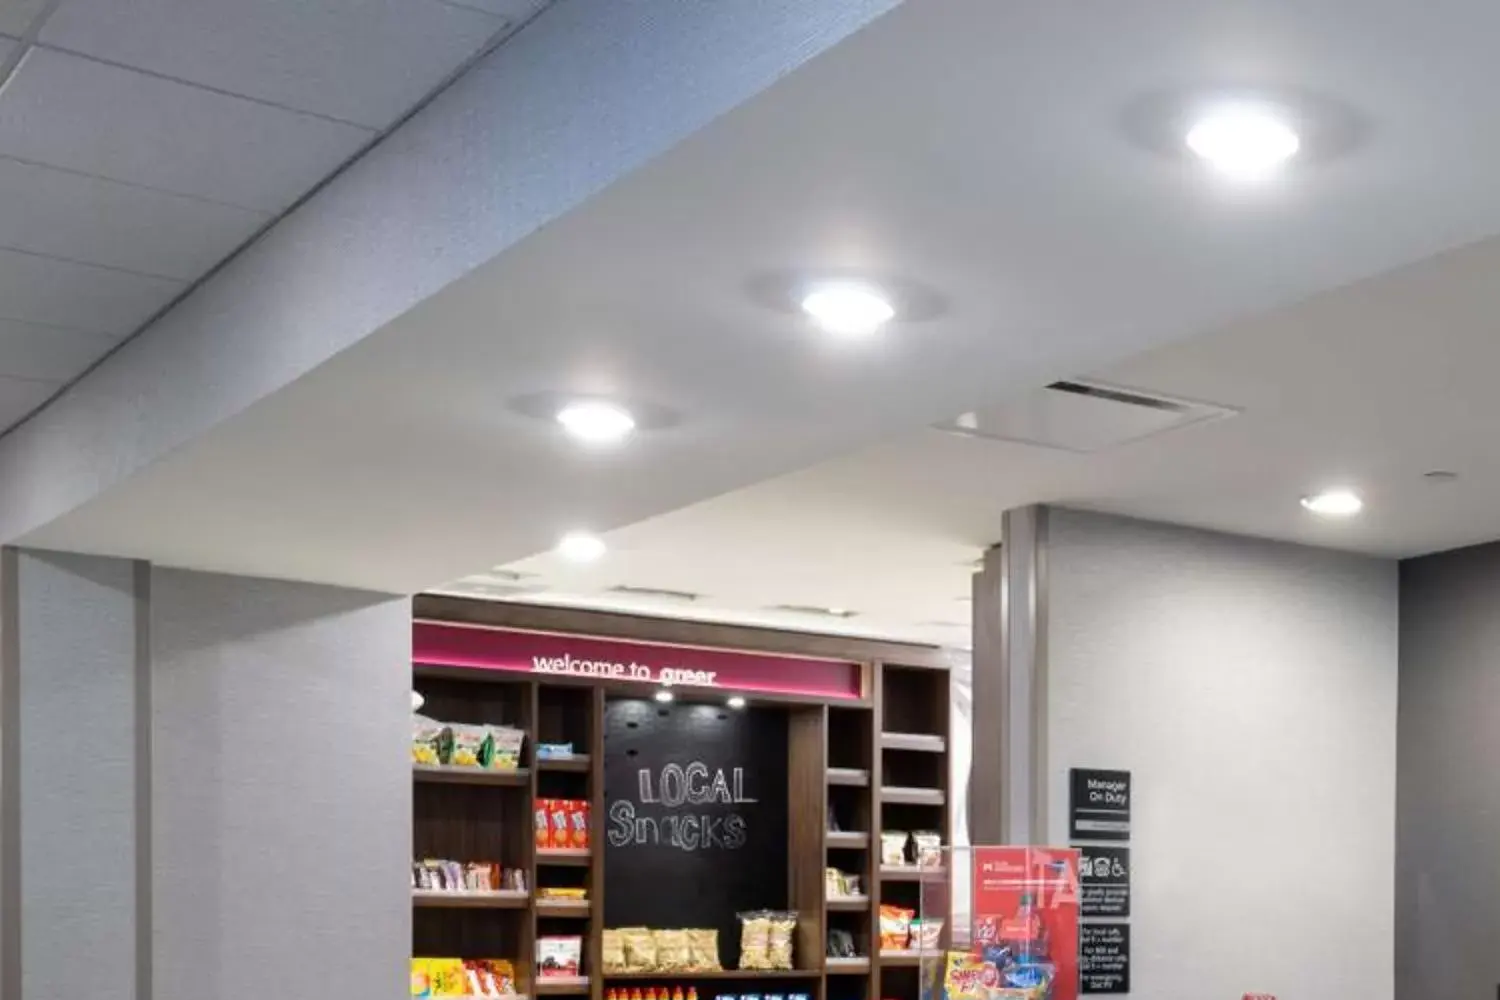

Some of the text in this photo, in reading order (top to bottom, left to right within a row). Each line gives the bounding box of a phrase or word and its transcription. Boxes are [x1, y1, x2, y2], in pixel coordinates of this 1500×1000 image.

[533, 653, 625, 677] welcome
[630, 661, 651, 679] to
[637, 760, 760, 808] LOCAL
